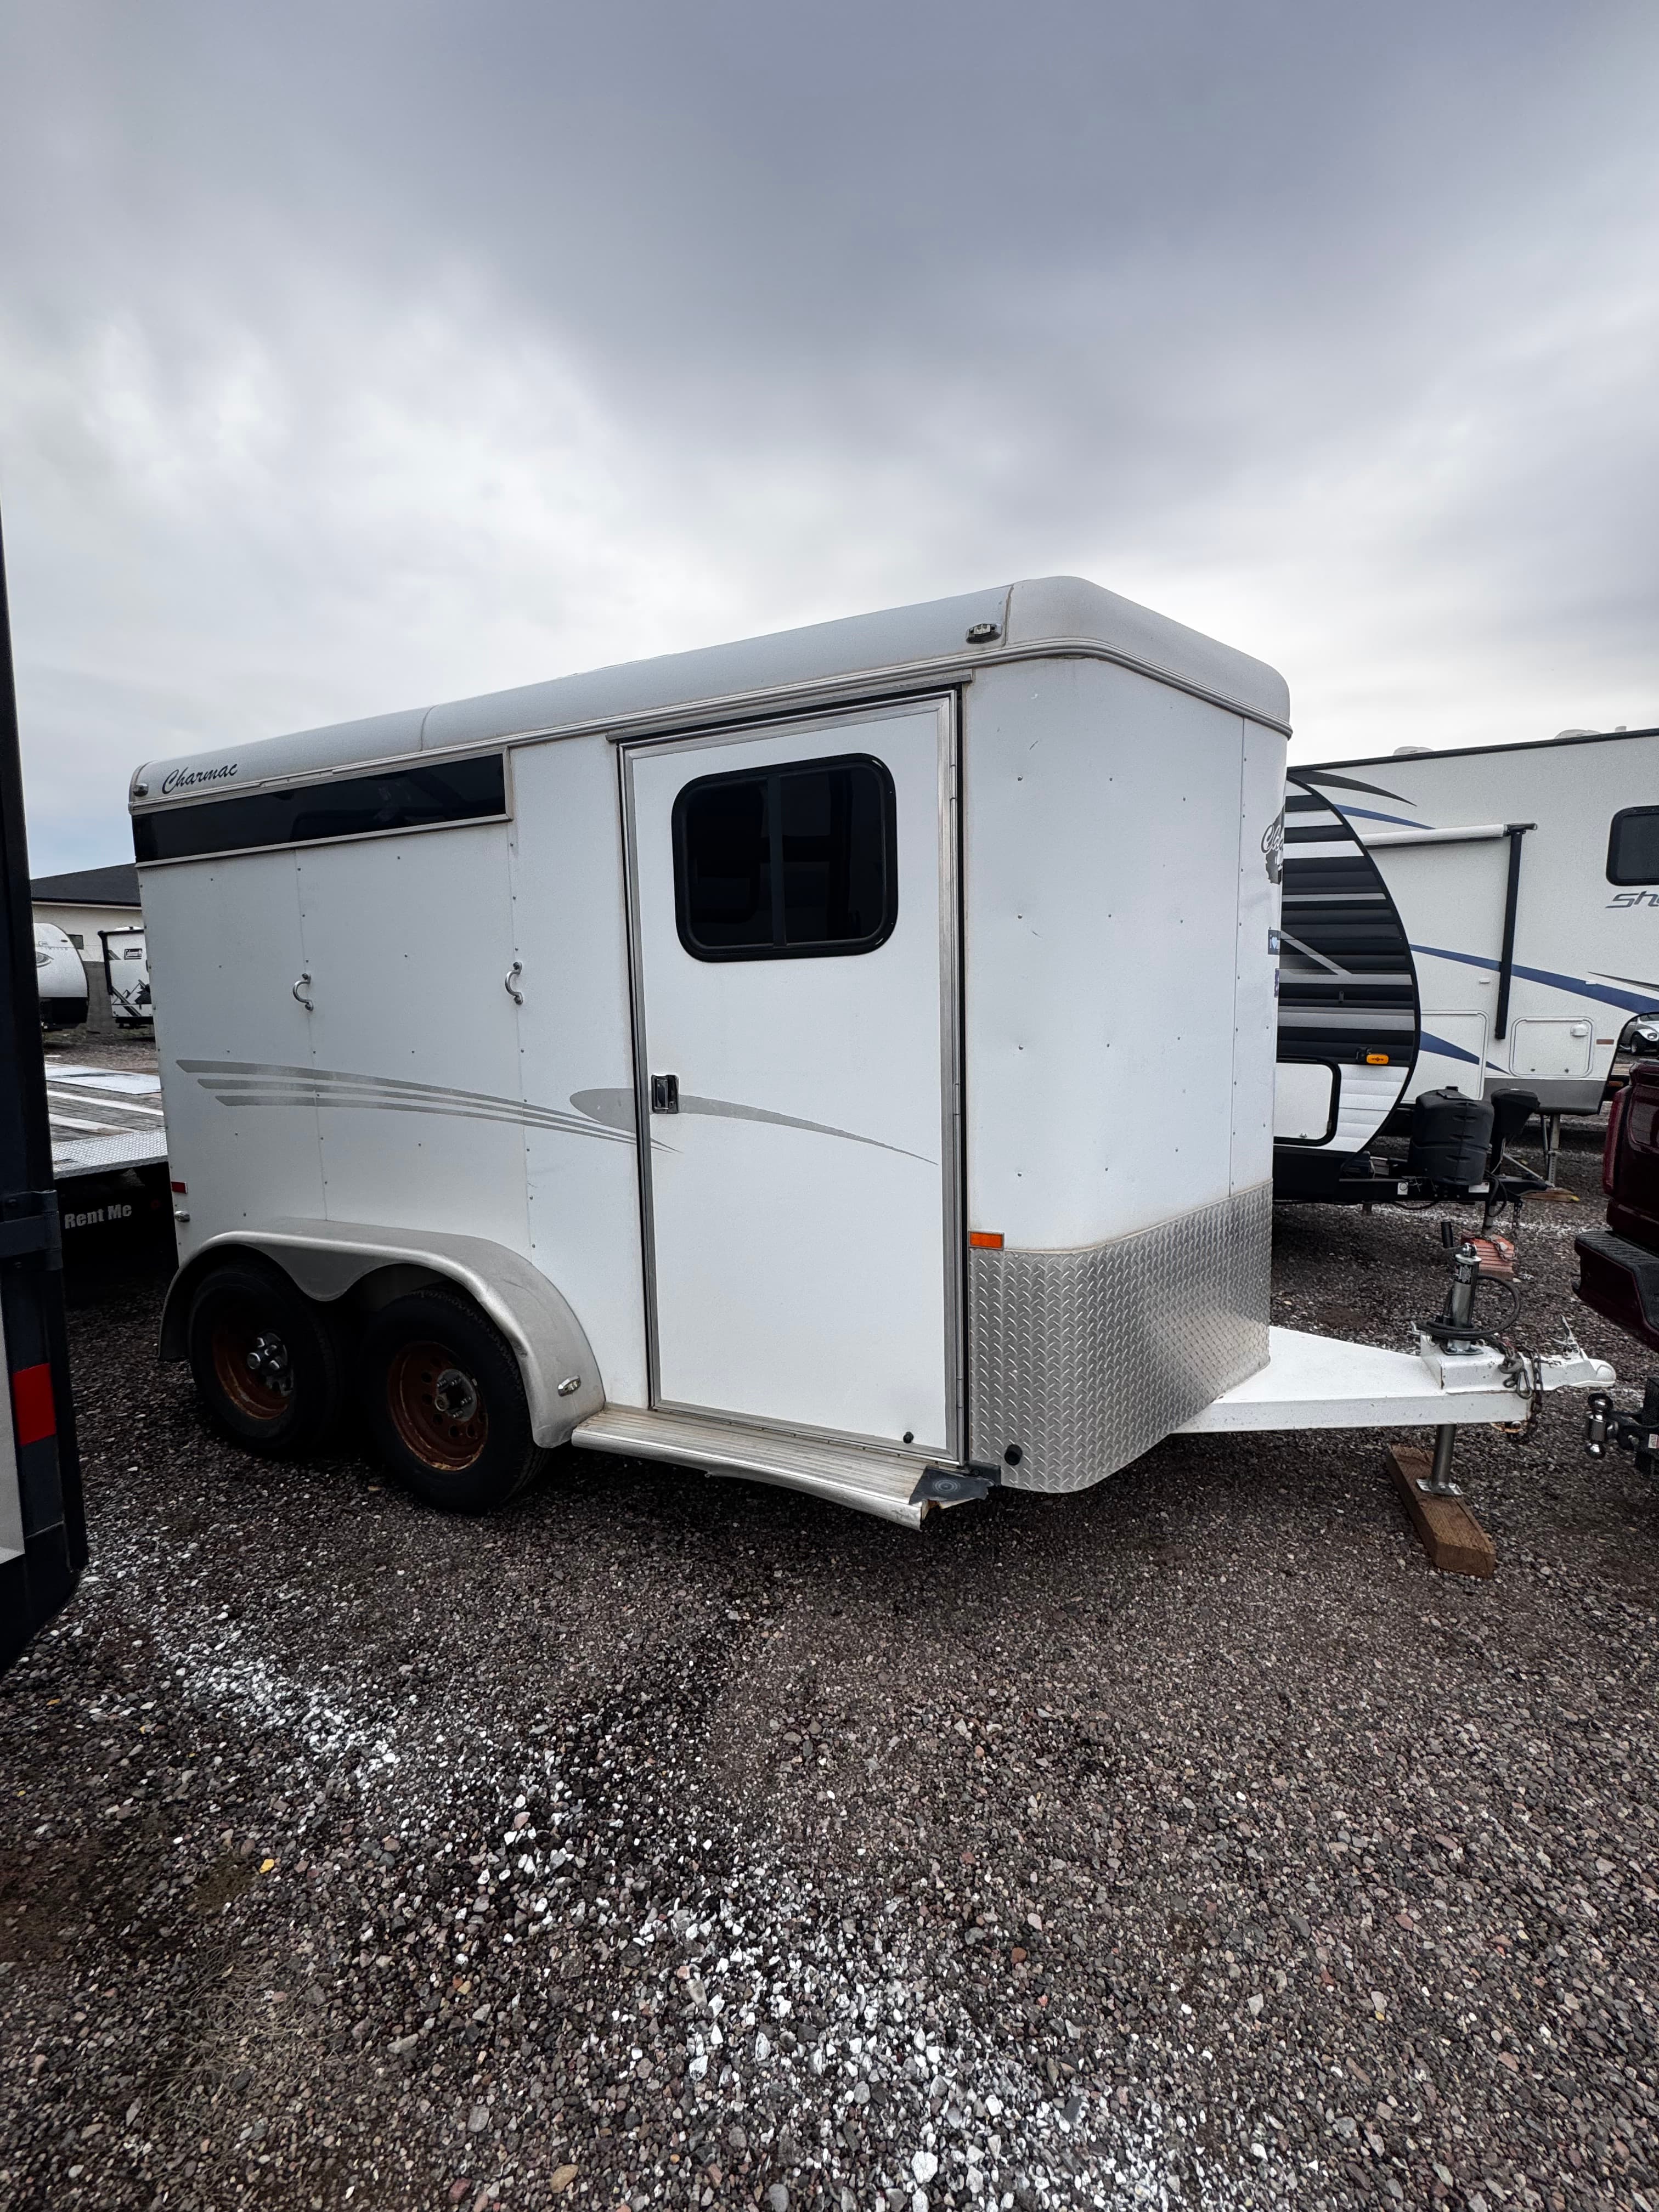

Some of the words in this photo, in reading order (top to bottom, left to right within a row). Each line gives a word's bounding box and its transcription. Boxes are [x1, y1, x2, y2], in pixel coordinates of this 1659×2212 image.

[162, 764, 238, 794] Charmac
[1605, 890, 1659, 909] Sh
[64, 1209, 104, 1229] Rent
[108, 1204, 132, 1221] Me
